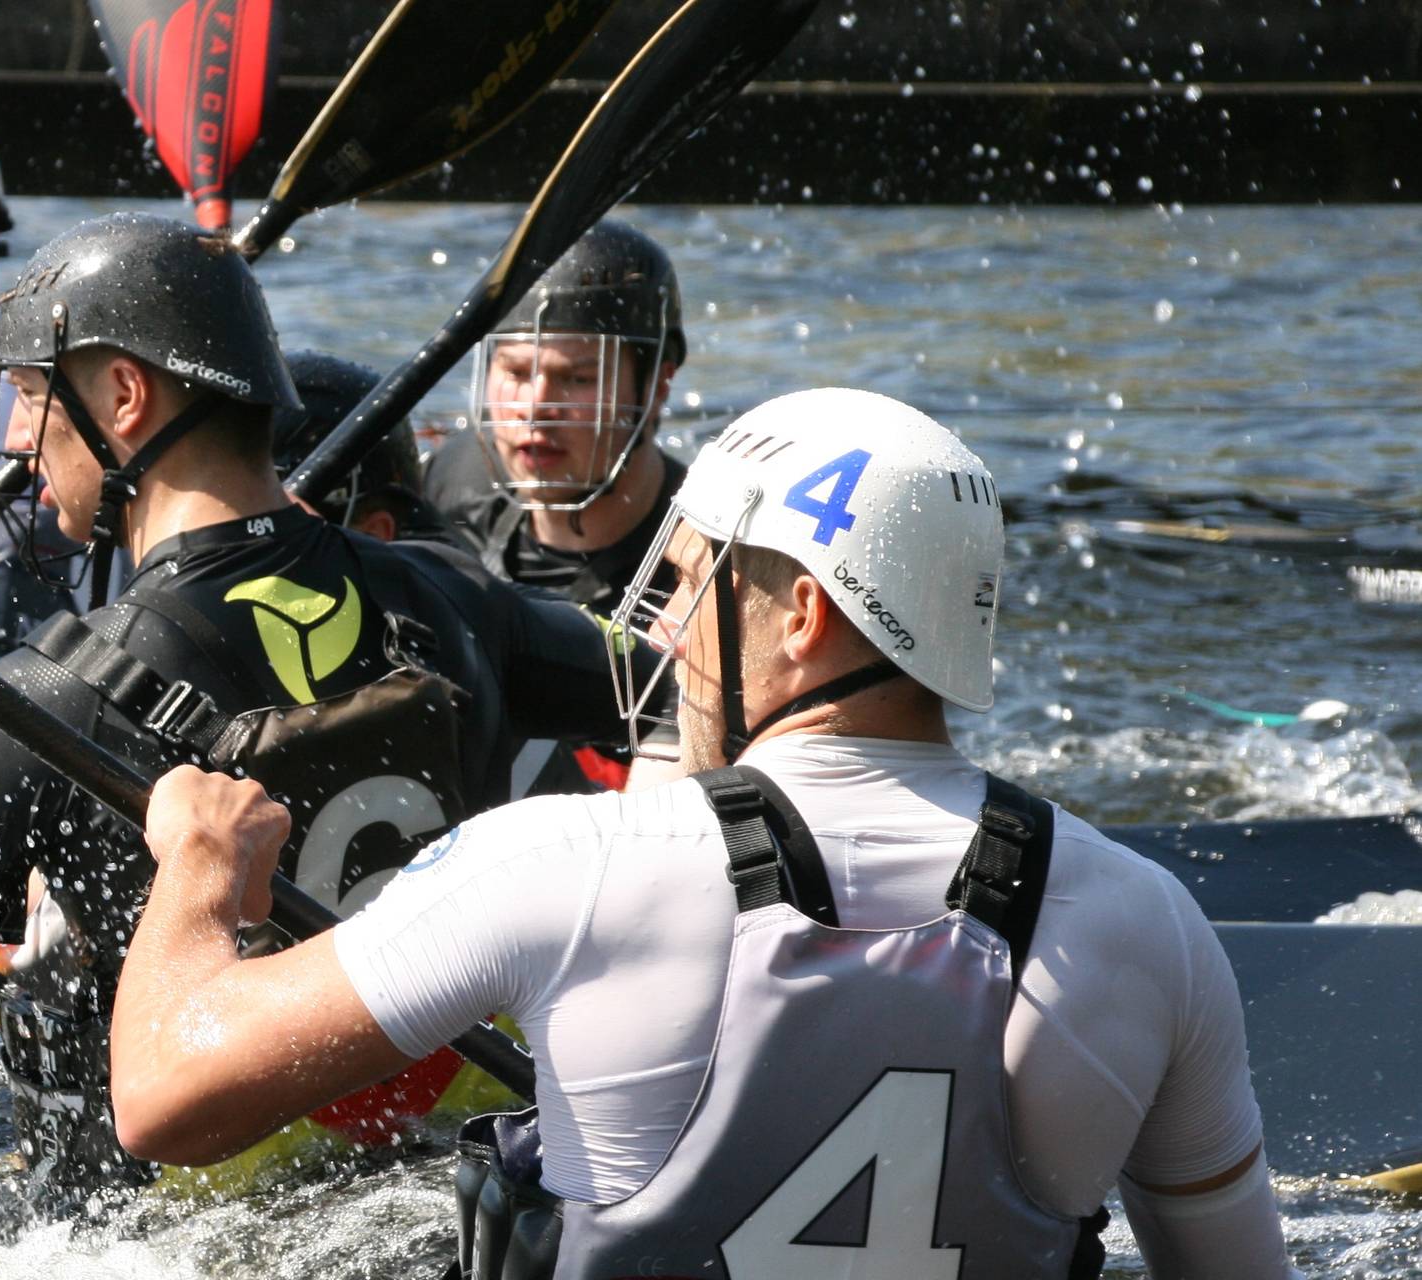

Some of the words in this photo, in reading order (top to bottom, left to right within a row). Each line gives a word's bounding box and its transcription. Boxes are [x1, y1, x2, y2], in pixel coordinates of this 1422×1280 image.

[195, 11, 234, 176] FALCON
[166, 348, 252, 396] bertecorp
[782, 448, 873, 547] 4
[833, 559, 915, 651] bertecorp
[717, 1066, 966, 1280] 4
